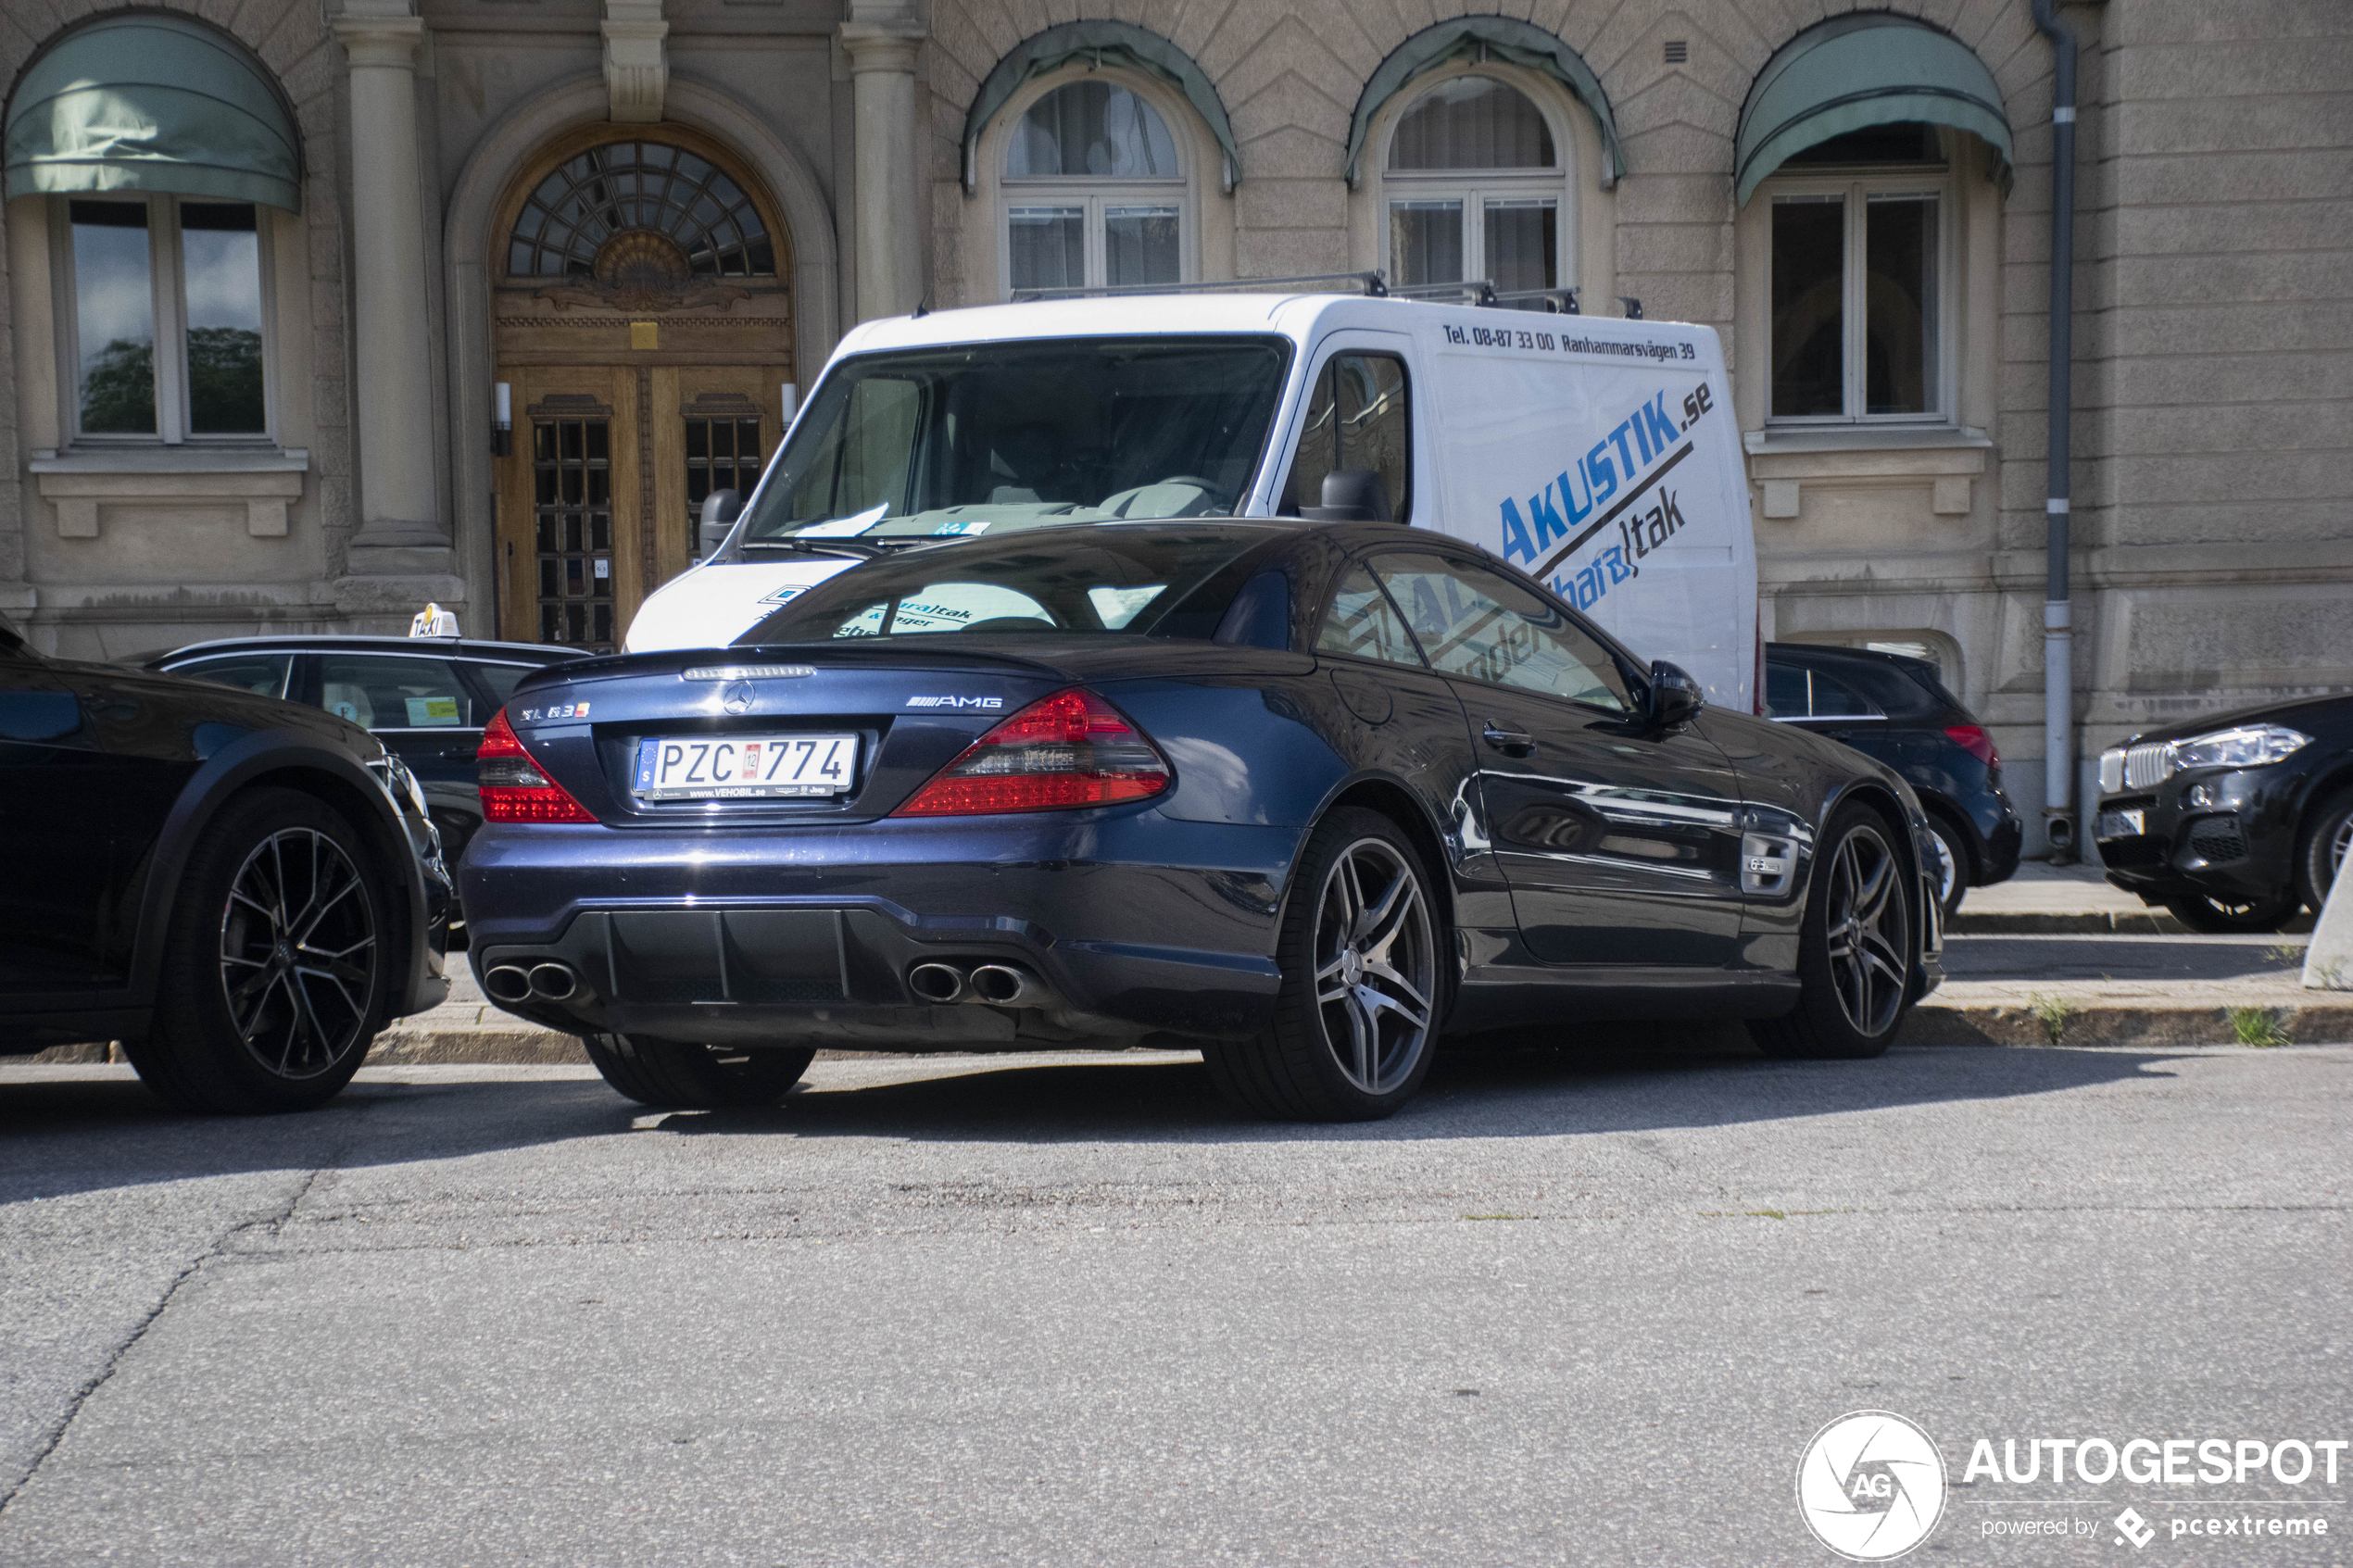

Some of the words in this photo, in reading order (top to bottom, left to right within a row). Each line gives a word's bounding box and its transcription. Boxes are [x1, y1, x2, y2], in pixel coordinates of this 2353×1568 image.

[1443, 325, 1470, 345] Tel.
[1472, 328, 1512, 348] 08-87
[1517, 331, 1534, 350] 33
[1536, 332, 1555, 351] 00
[1561, 334, 1678, 362] Ranhammarsvägen
[1679, 343, 1695, 360] 39
[415, 617, 440, 636] TAXI
[935, 696, 1002, 709] AMG
[547, 705, 574, 719] 63
[642, 771, 650, 782] S
[661, 744, 735, 784] PZC
[765, 741, 842, 780] 774
[747, 753, 757, 767] 12
[689, 787, 766, 798] www.VEHOBIL.se
[809, 785, 825, 795] Jeep
